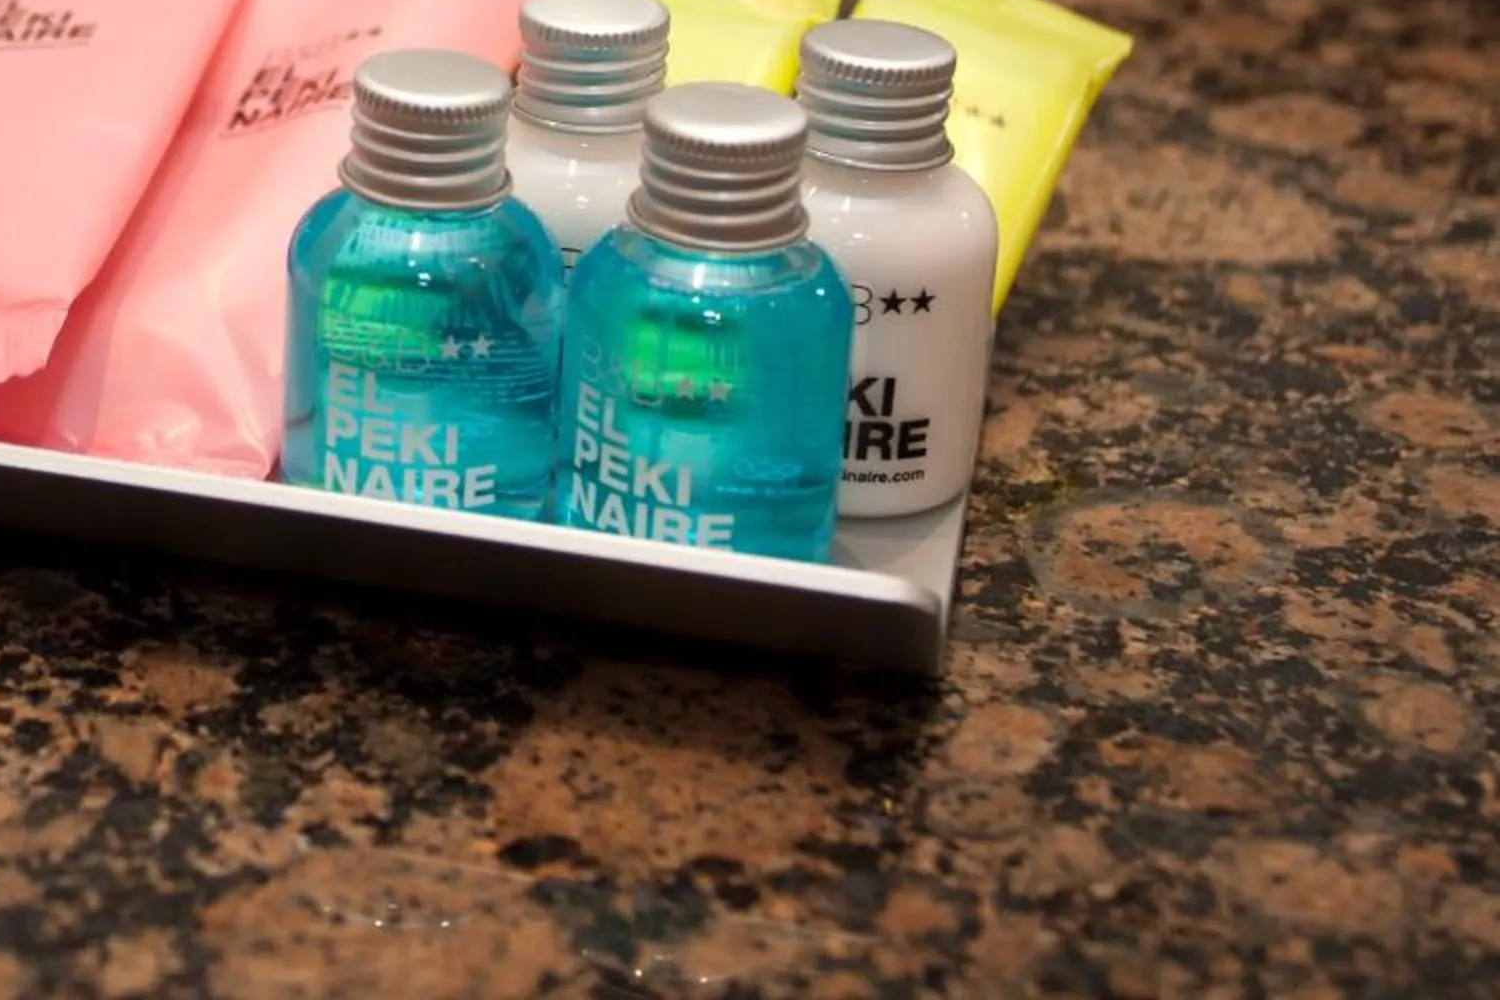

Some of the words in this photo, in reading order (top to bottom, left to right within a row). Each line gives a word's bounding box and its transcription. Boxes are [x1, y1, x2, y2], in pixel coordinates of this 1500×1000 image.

[329, 361, 393, 414] EL
[576, 381, 629, 446] EL
[849, 376, 897, 417] KI
[325, 405, 459, 465] PEKI
[843, 418, 930, 460] IRE
[324, 450, 497, 510] NAIRE
[573, 427, 692, 507] PEKI
[841, 468, 925, 484] inaire.com
[570, 472, 734, 551] NAIRE
